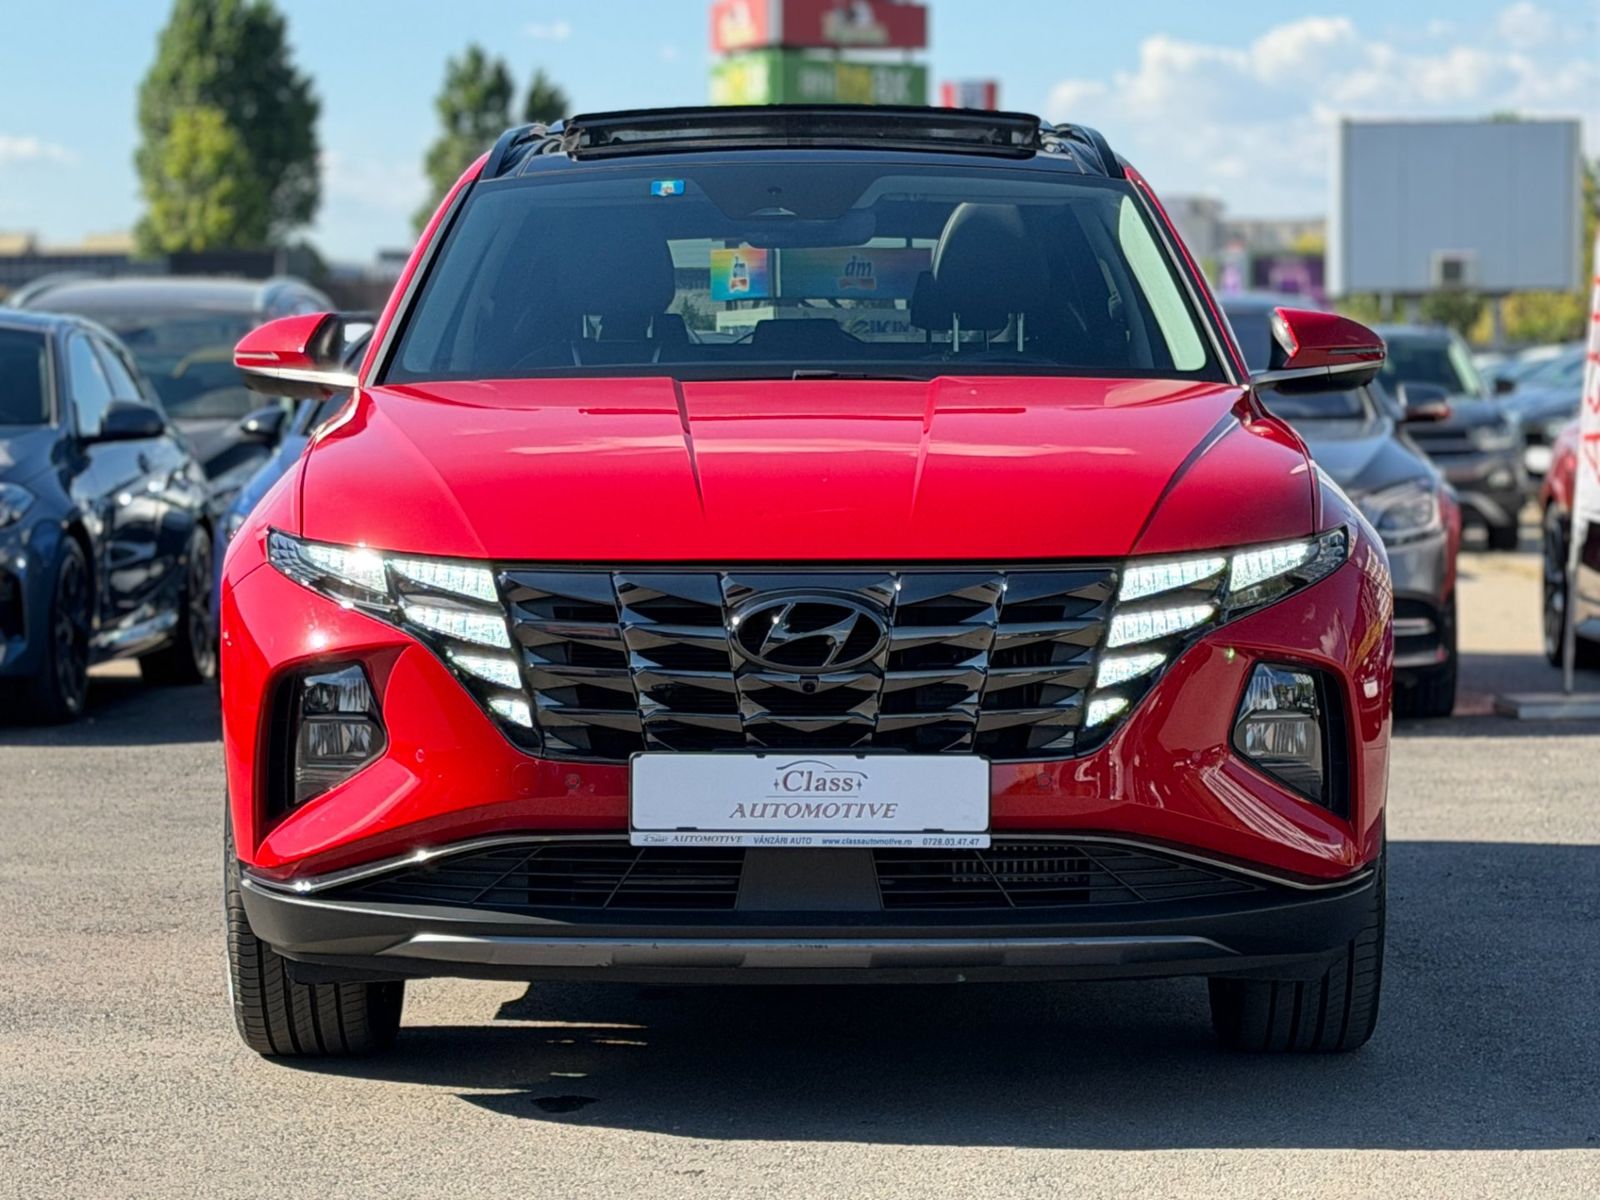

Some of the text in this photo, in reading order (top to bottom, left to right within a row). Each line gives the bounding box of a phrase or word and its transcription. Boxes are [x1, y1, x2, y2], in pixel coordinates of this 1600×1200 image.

[845, 255, 872, 277] dm
[782, 770, 854, 792] Class
[729, 802, 898, 819] AUTOMOTIVE
[672, 834, 744, 844] AUTOMOTIVE
[789, 836, 813, 846] AUTO
[822, 837, 913, 846] www.classautomotive.ro
[922, 837, 980, 847] 0728.03.47.47
